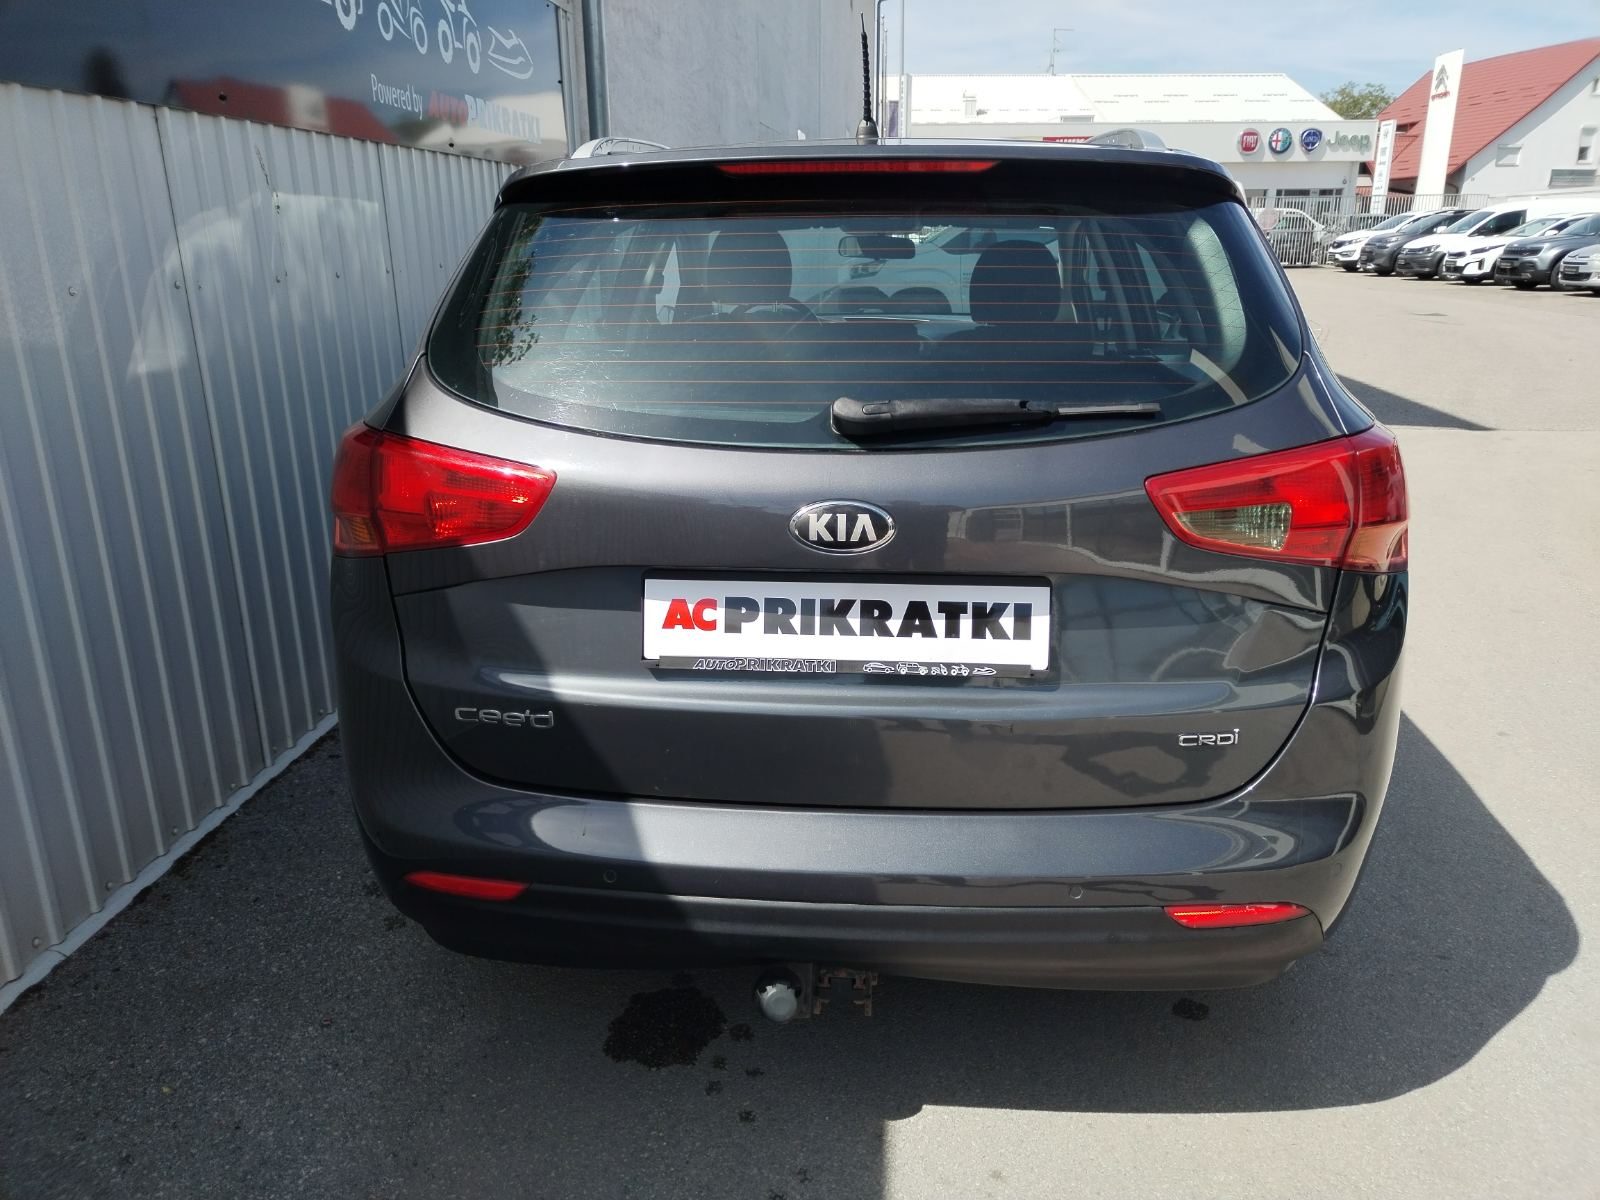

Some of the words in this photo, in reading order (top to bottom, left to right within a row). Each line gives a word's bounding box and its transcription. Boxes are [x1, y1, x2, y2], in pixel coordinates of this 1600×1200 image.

[370, 73, 411, 111] Powered
[412, 84, 423, 120] by
[1326, 130, 1371, 151] Jeep
[807, 513, 877, 541] KIA
[1179, 728, 1240, 746] CRDi
